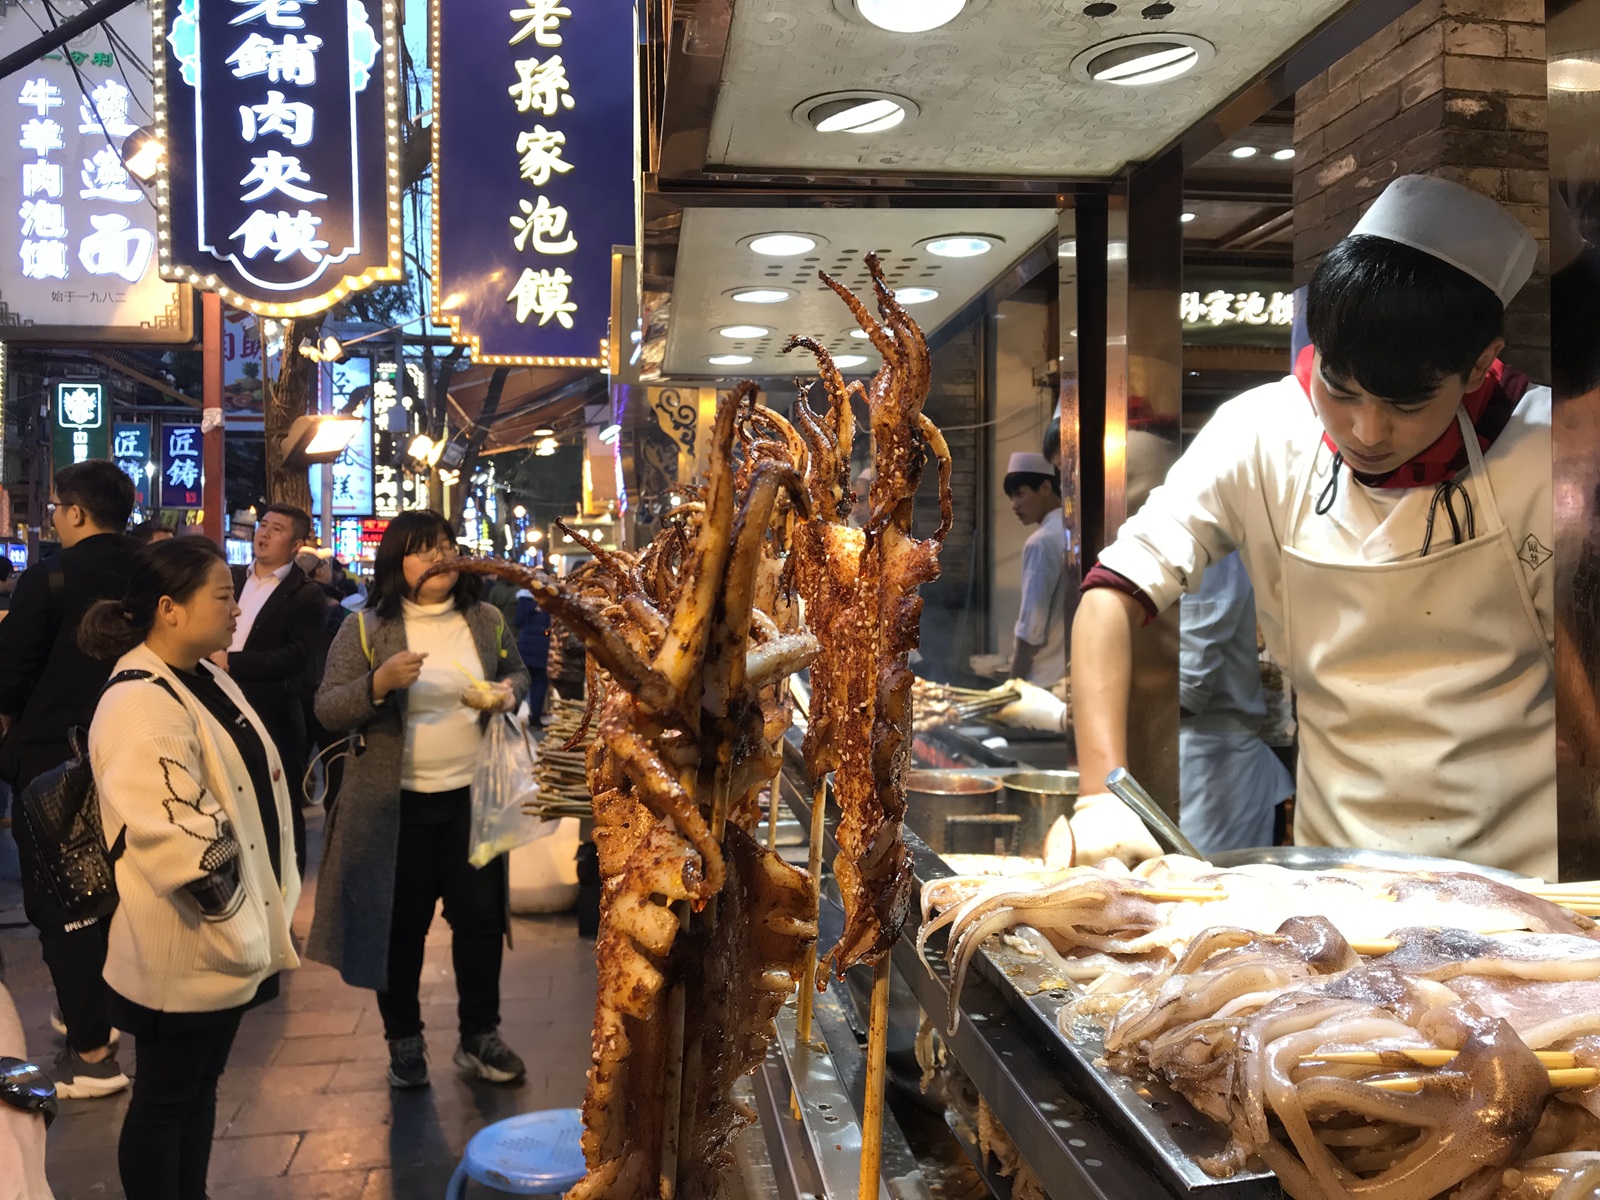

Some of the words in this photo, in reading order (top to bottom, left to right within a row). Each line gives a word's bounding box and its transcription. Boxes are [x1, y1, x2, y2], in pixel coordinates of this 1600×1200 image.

[51, 290, 127, 303] 始于一九八二
[167, 427, 199, 489] 匠铸
